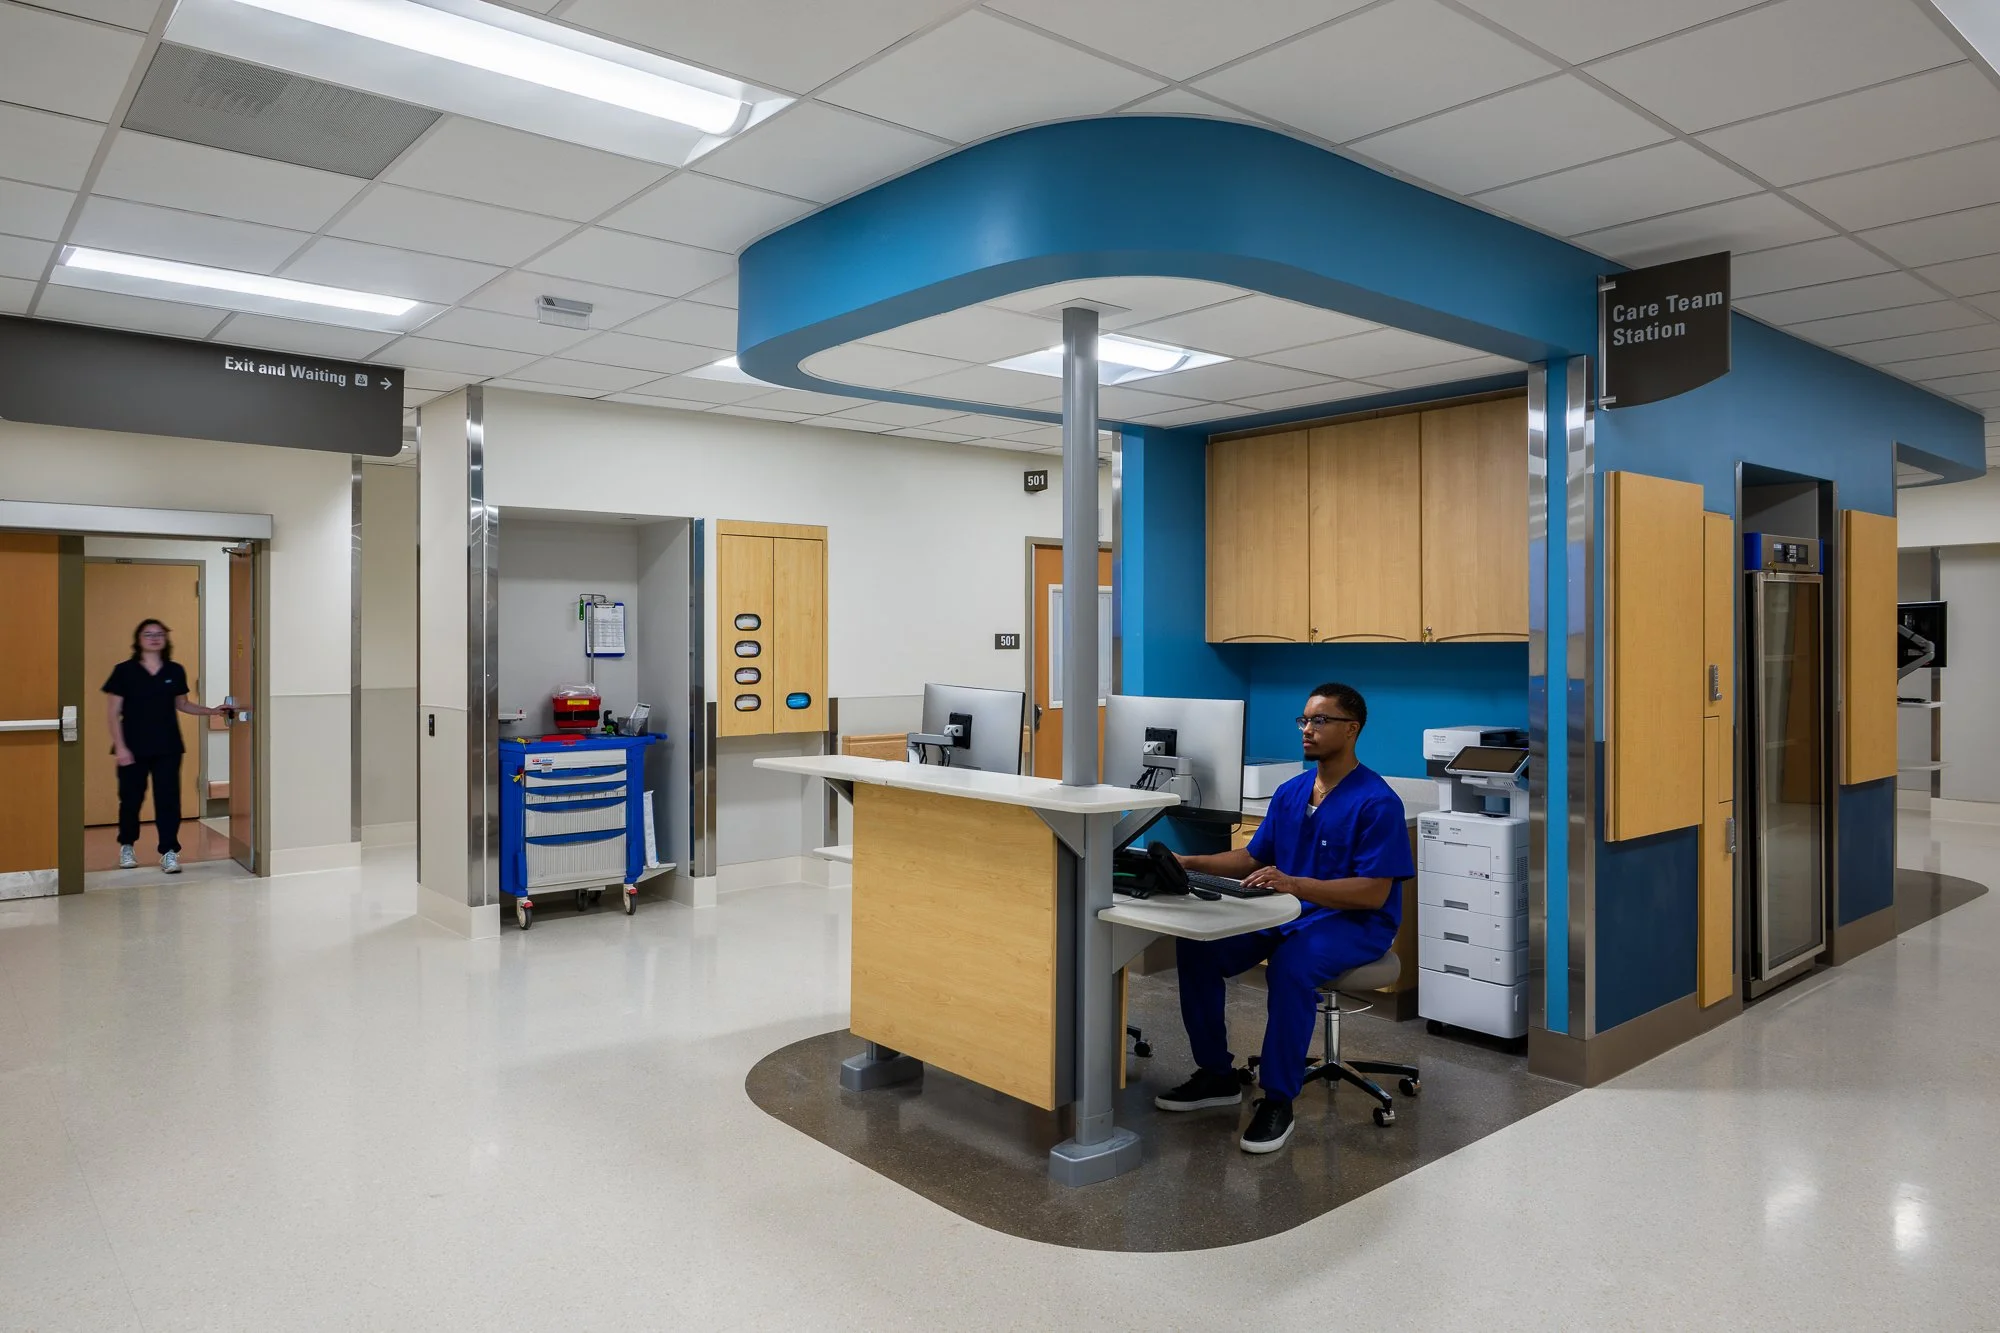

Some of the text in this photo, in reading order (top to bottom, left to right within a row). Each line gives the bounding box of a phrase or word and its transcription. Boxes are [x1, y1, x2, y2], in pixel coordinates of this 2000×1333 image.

[1613, 291, 1723, 323] Care Team
[1613, 322, 1686, 346] Station
[225, 356, 346, 387] Exit and Waiting
[1027, 475, 1045, 486] 501
[1000, 635, 1015, 646] 501
